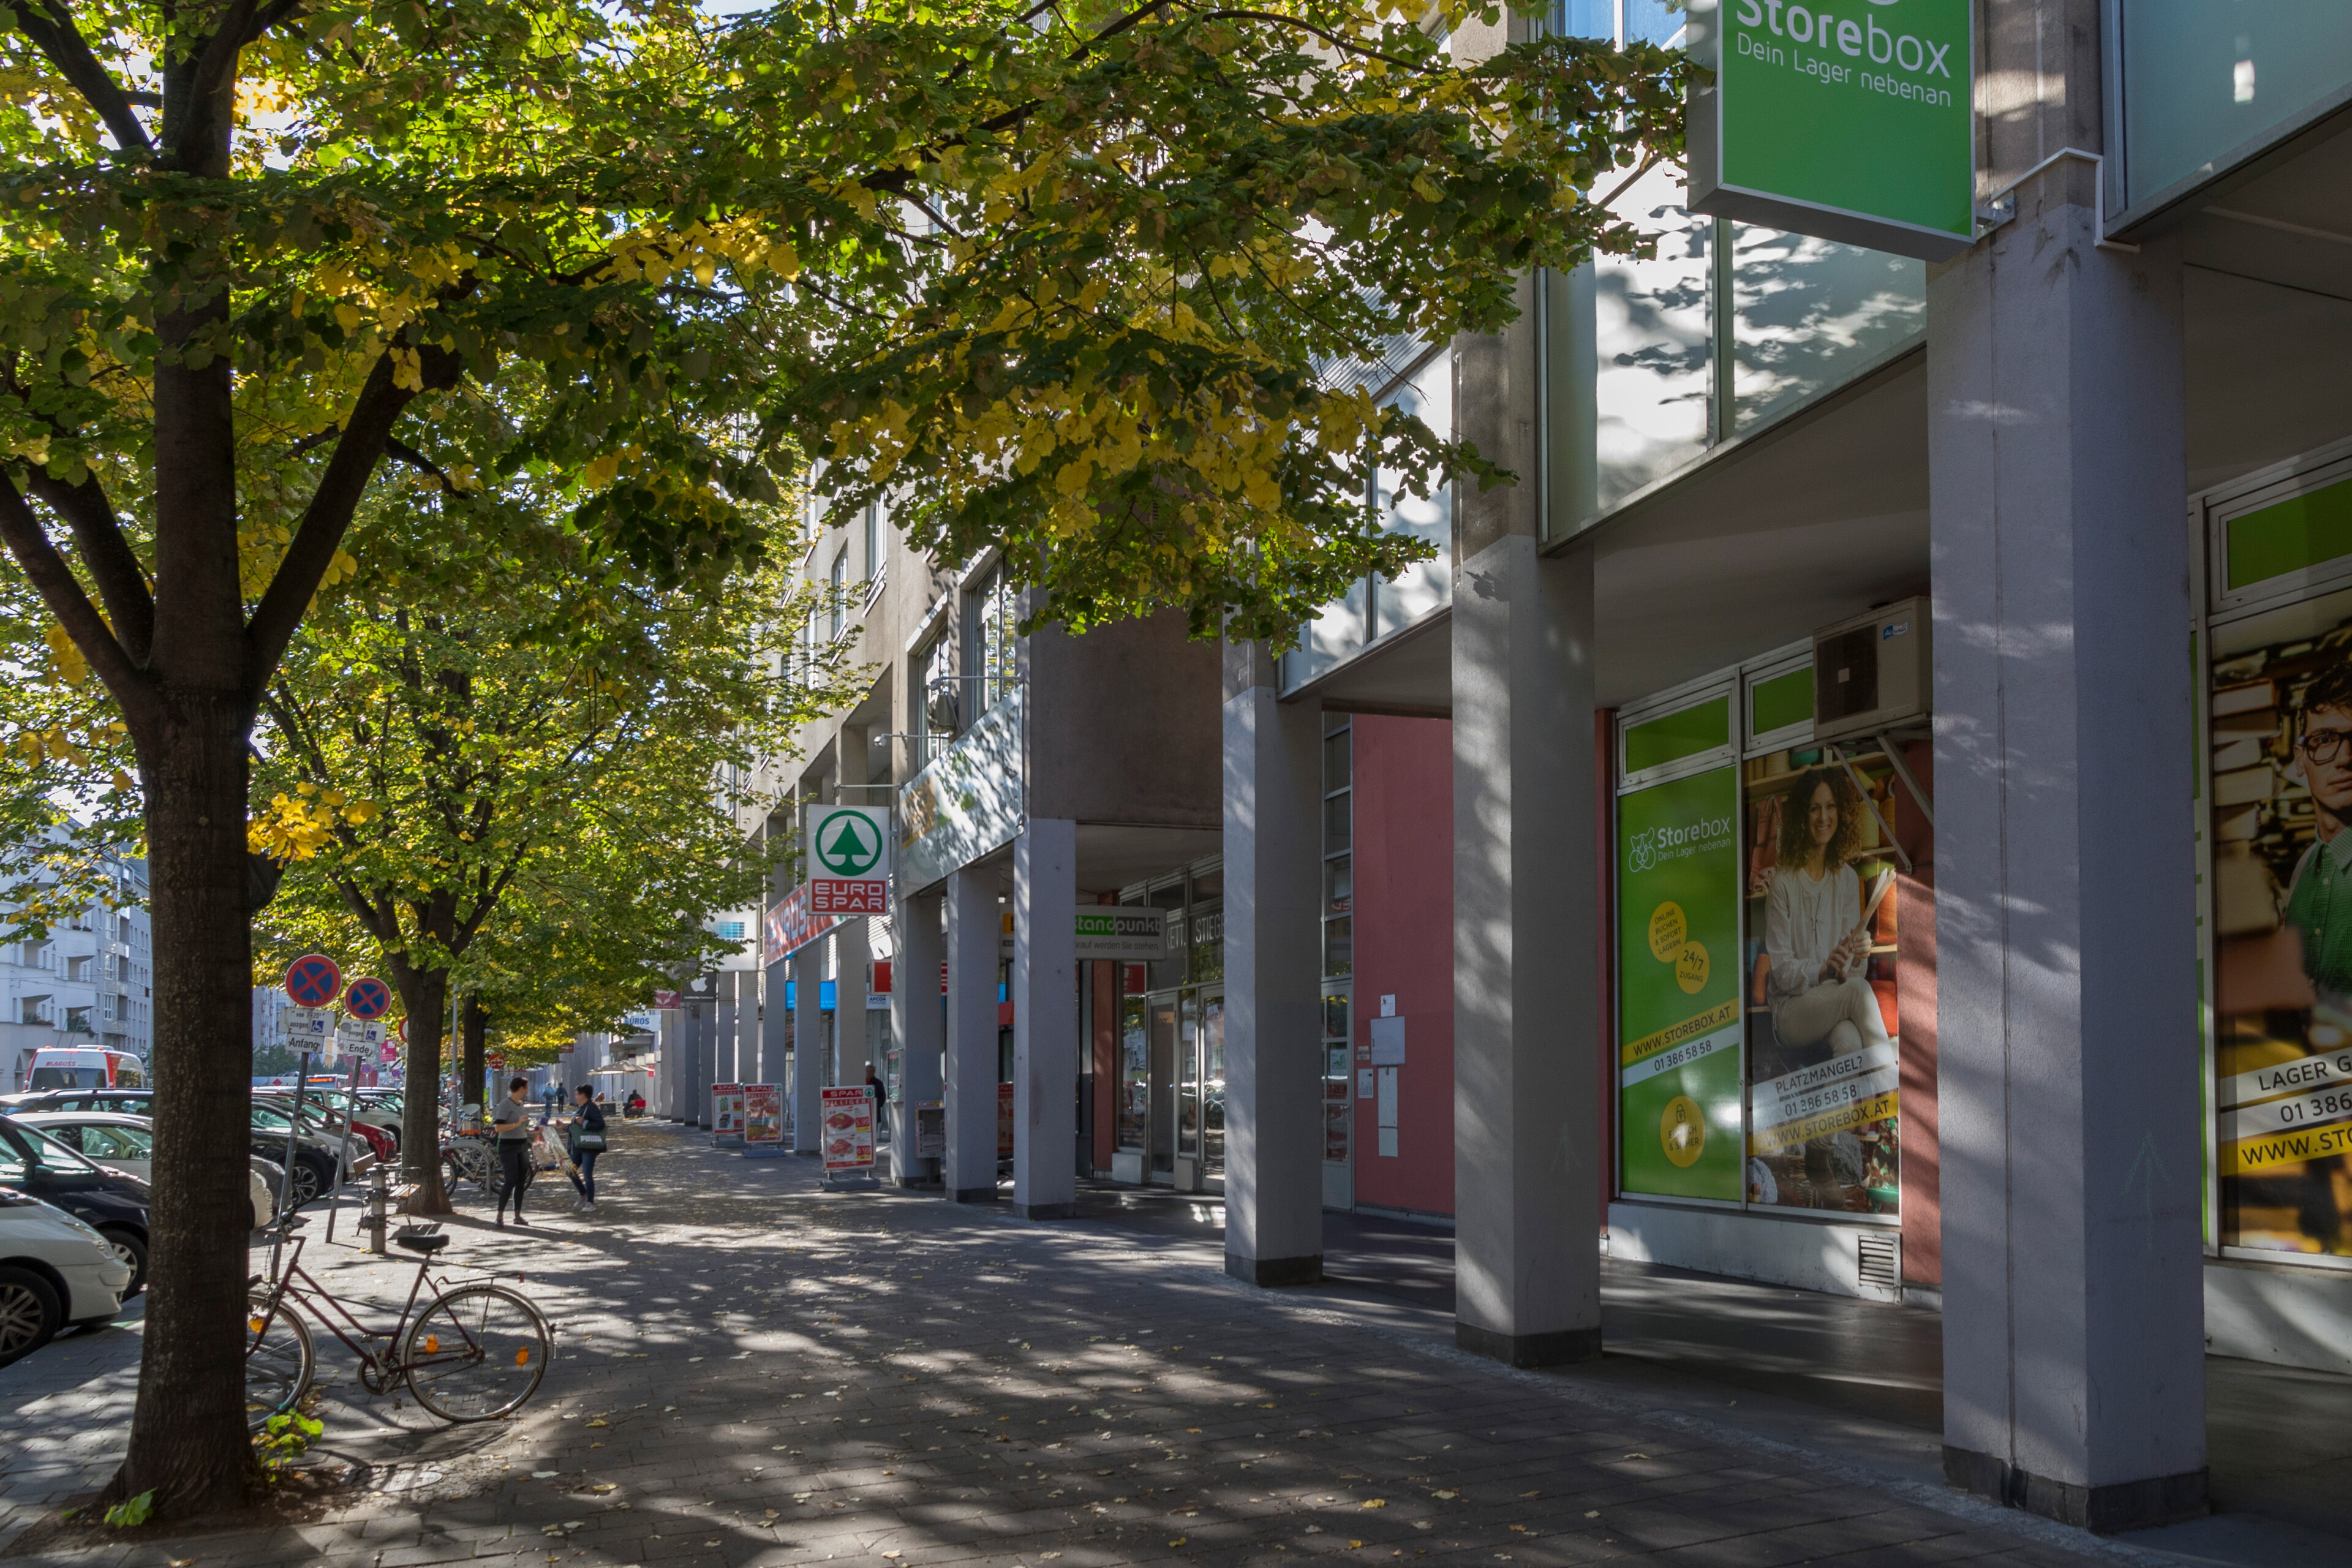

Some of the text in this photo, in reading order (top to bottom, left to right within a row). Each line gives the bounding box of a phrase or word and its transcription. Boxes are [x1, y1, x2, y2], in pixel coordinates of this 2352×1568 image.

[1736, 0, 1951, 78] Storebox
[1737, 32, 1951, 107] Dein Lager nebenan
[1657, 816, 1731, 849] Storebox
[1658, 838, 1731, 861] Dein Lager nebenan
[815, 882, 883, 895] EURO
[815, 896, 883, 910] SPAR
[1654, 908, 1676, 924] ONLINE
[1655, 918, 1678, 935] BUCHEN
[1660, 926, 1681, 943] SOFORT
[1094, 941, 1120, 949] werden
[1121, 941, 1133, 949] Sie
[1659, 938, 1681, 955] LAGERN
[1683, 949, 1704, 971] 24/7
[1679, 971, 1703, 982] ZUGANG
[1633, 1006, 1730, 1057] WWW.STOREBOX.AT
[288, 1037, 319, 1052] Anfang
[349, 1044, 369, 1054] Ende
[1654, 1040, 1712, 1071] 01 386 58 58
[1776, 1055, 1863, 1093] PLATZMANGEL?
[2258, 1061, 2329, 1091] LAGER
[1785, 1084, 1857, 1117] 01 386 58 58
[2280, 1092, 2352, 1123] 01 386
[1668, 1125, 1697, 1139] EICH
[1765, 1100, 1889, 1147] WWW.STOREBOX.AT
[1669, 1137, 1699, 1151] & SHER
